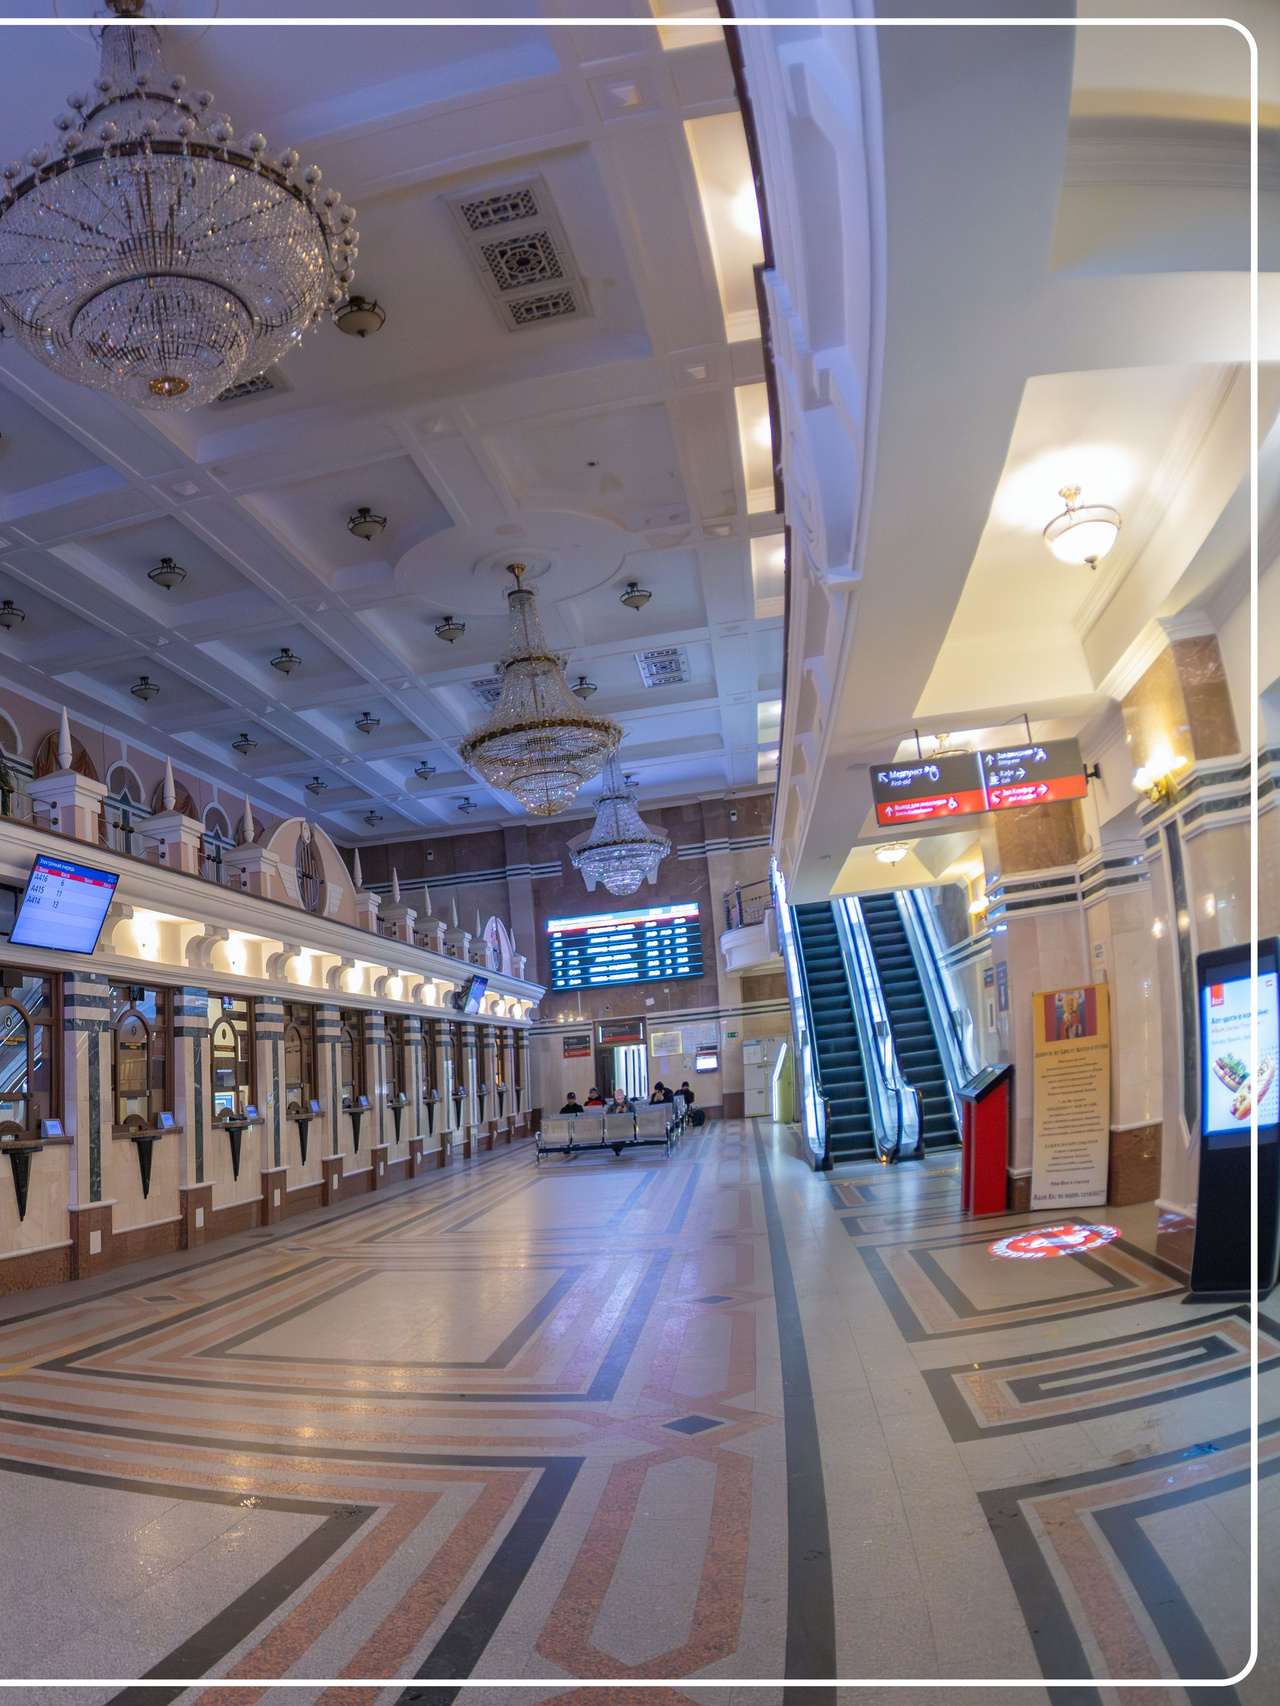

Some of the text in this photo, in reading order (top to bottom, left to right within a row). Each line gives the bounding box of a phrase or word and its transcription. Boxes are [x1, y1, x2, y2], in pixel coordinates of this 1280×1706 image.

[889, 768, 923, 778] Медпункт
[1000, 769, 1014, 777] Кафе
[39, 857, 62, 868] Электронная
[60, 879, 65, 887] 6
[56, 890, 62, 898] 11
[52, 901, 59, 909] 13
